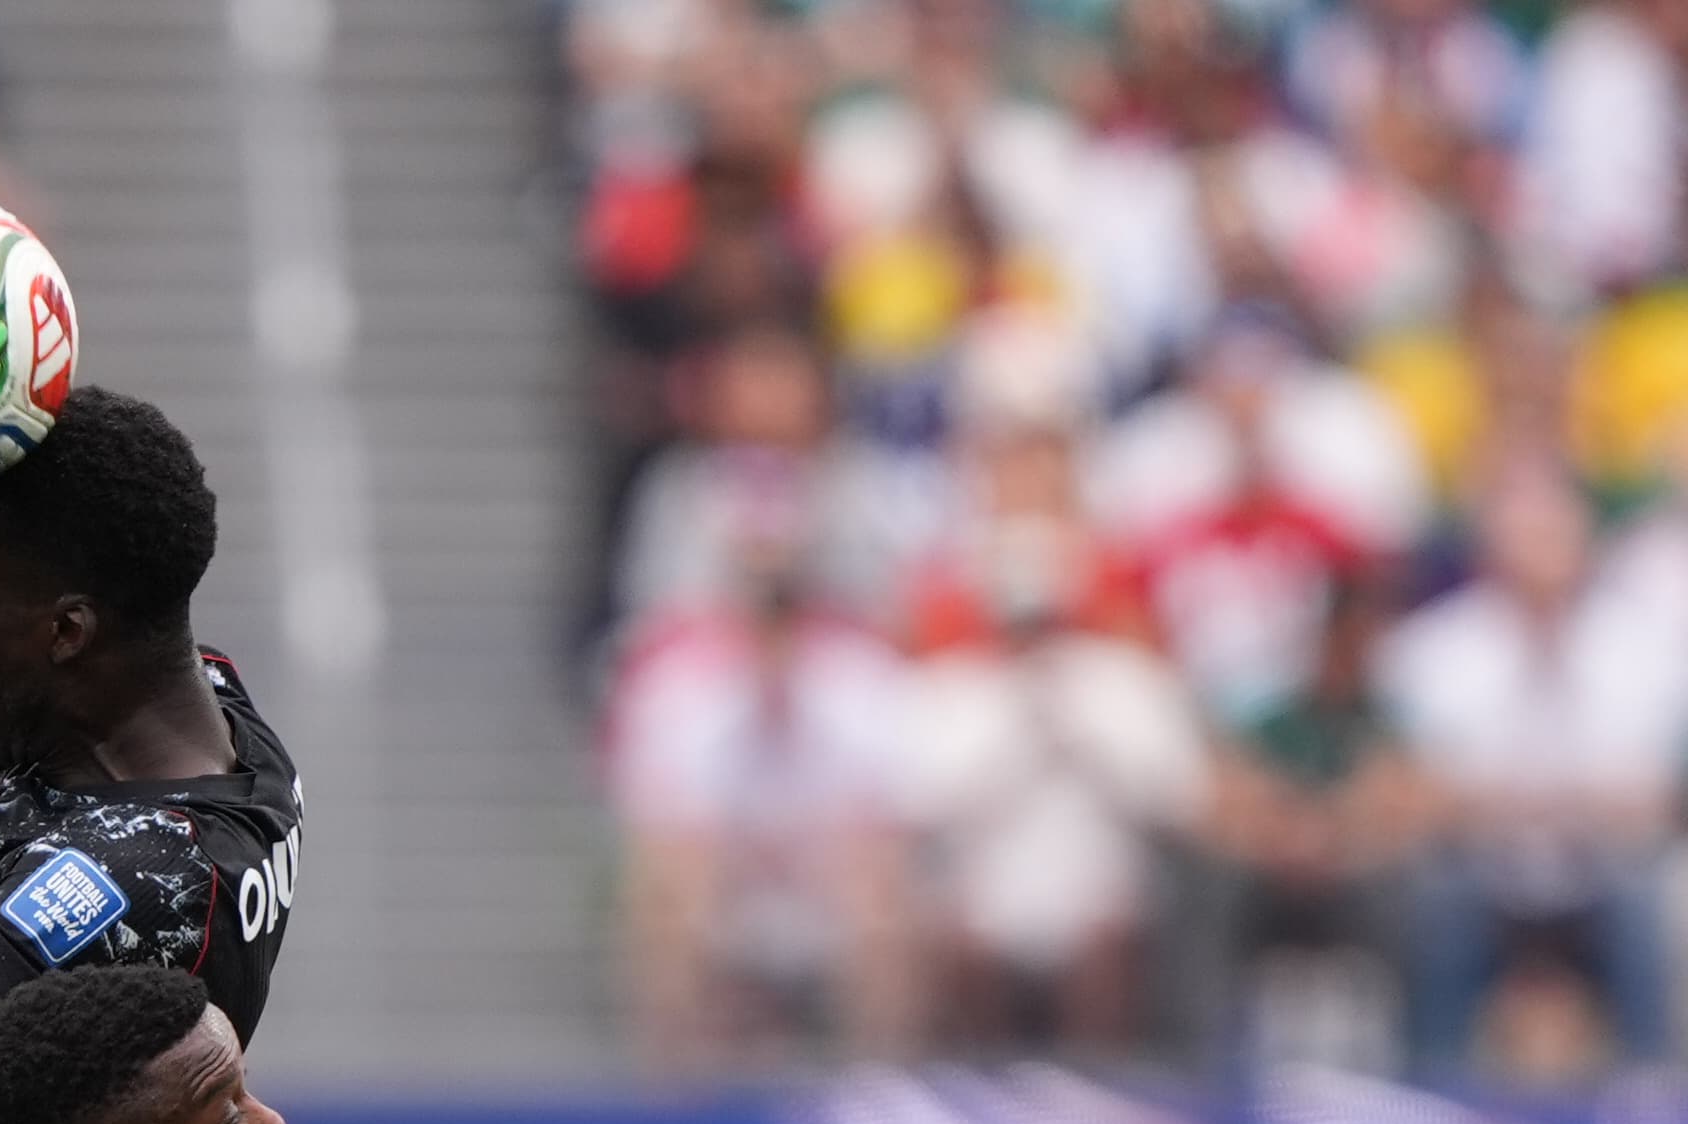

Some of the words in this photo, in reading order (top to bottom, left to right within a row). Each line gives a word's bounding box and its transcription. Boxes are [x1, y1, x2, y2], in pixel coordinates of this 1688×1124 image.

[46, 871, 98, 925] UNITES
[60, 862, 109, 912] FOOTBALL
[29, 886, 51, 907] the
[47, 901, 84, 941] World
[33, 910, 55, 933] FIFA
